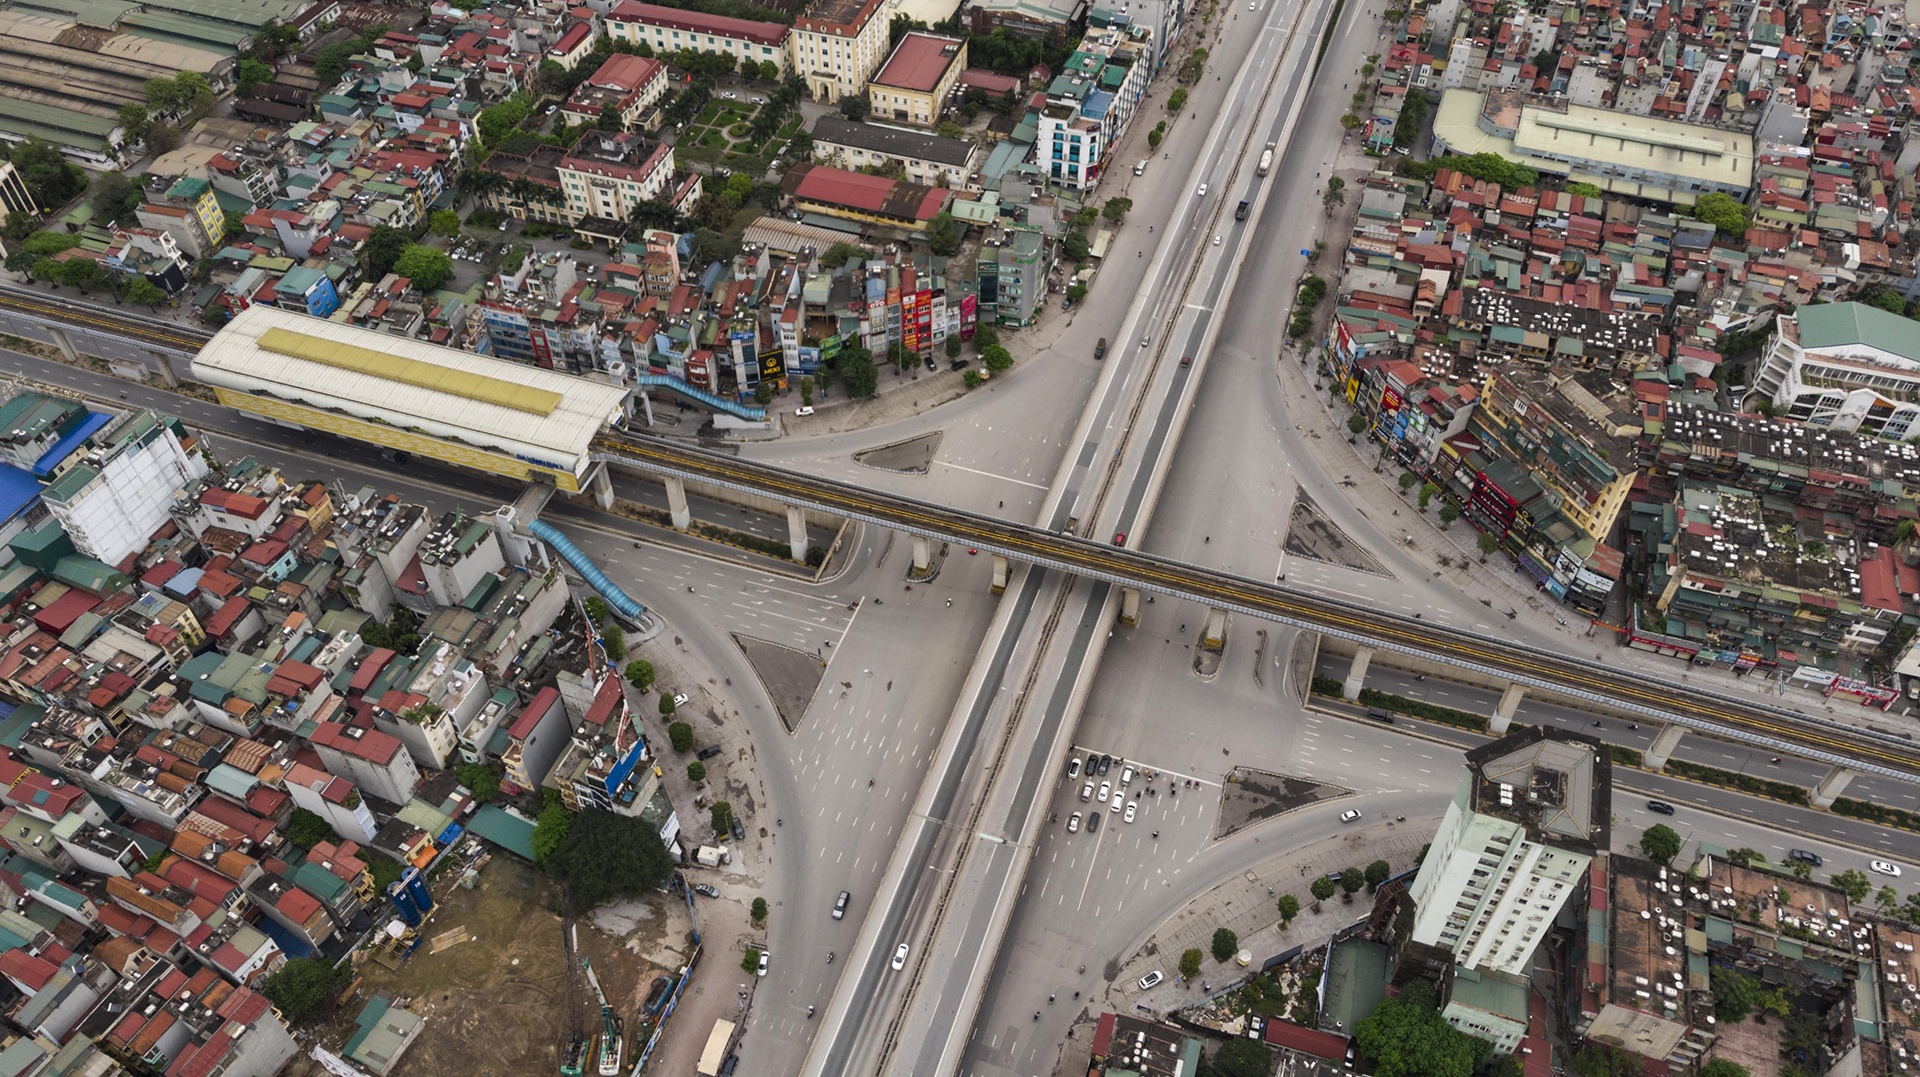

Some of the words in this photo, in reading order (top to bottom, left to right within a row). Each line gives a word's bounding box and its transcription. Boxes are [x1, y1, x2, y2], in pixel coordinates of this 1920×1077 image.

[1353, 242, 1392, 254] SUNHOUSE
[870, 300, 885, 309] OYO
[763, 366, 781, 376] MIXI
